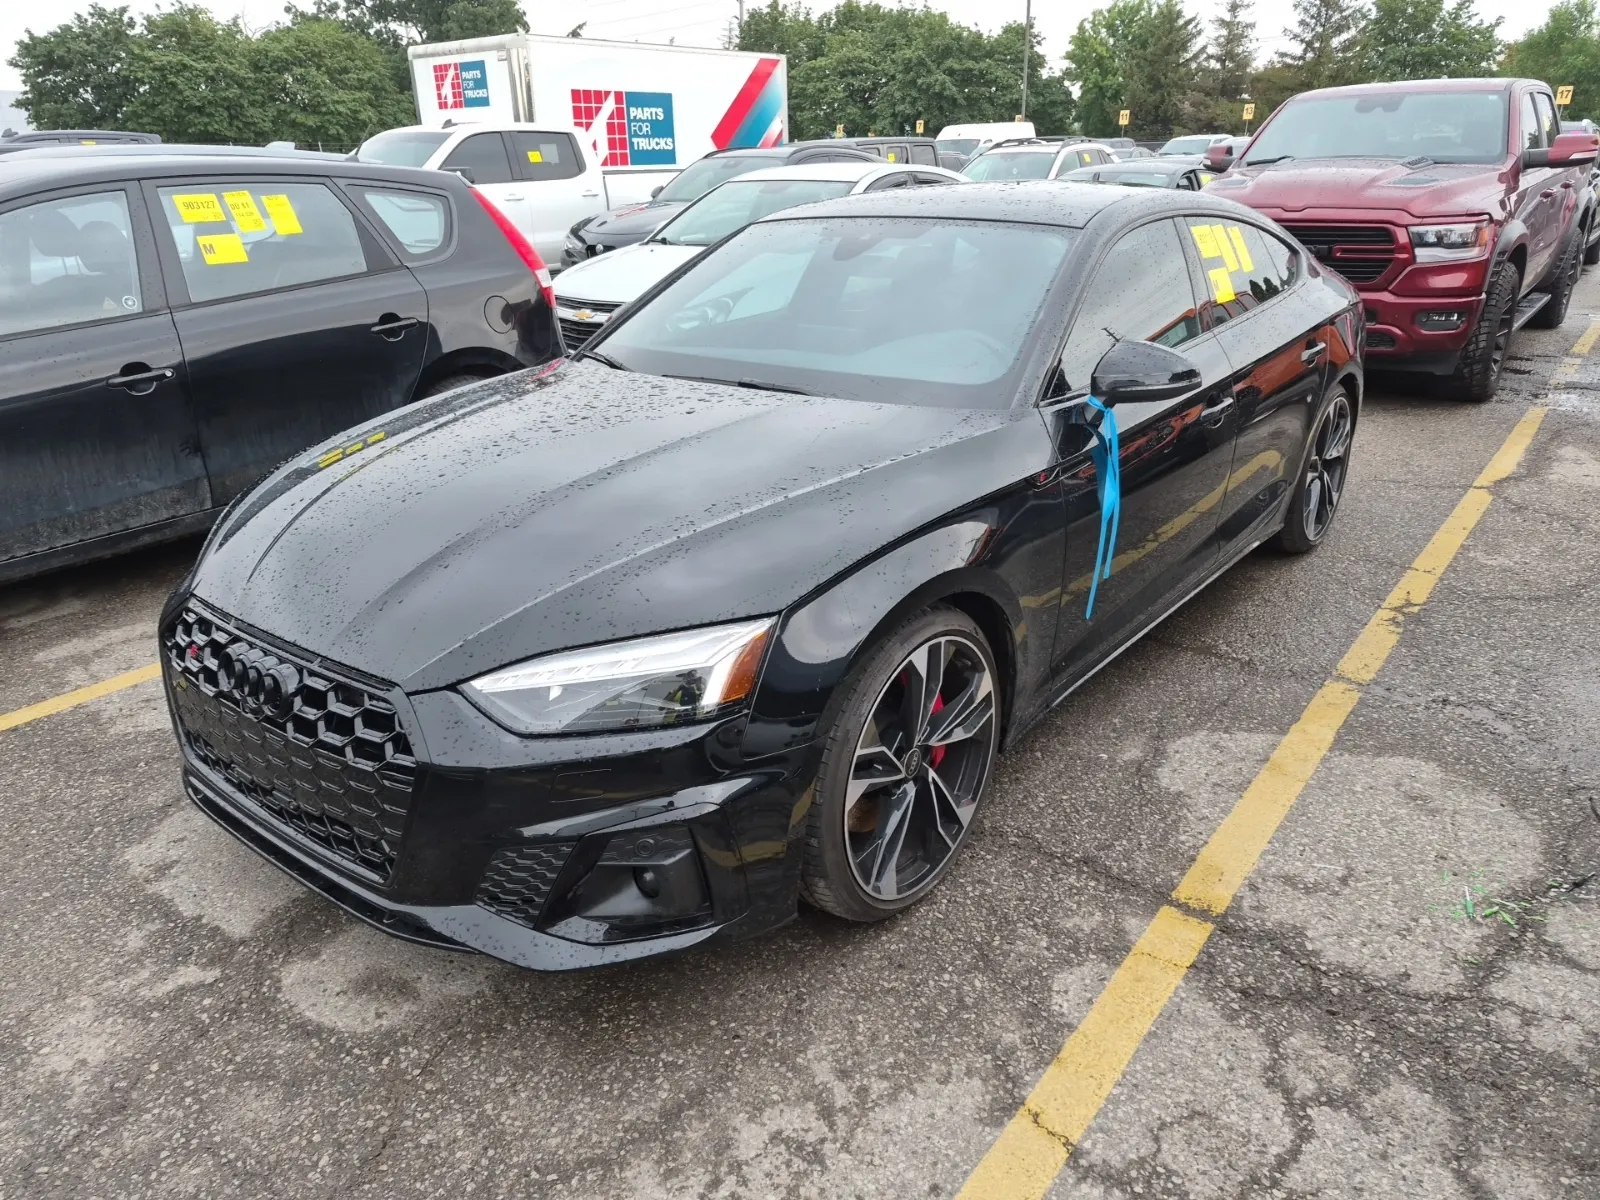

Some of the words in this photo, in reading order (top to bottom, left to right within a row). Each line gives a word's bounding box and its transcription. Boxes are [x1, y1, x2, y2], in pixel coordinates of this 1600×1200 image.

[461, 70, 481, 80] PARTS
[462, 80, 475, 90] FOR
[464, 89, 488, 99] TRUCKS
[1558, 89, 1572, 99] 17
[629, 107, 665, 121] PARTS
[631, 122, 652, 135] FOR
[632, 137, 675, 151] TRUCKS
[182, 201, 215, 210] 903127
[202, 243, 216, 255] M
